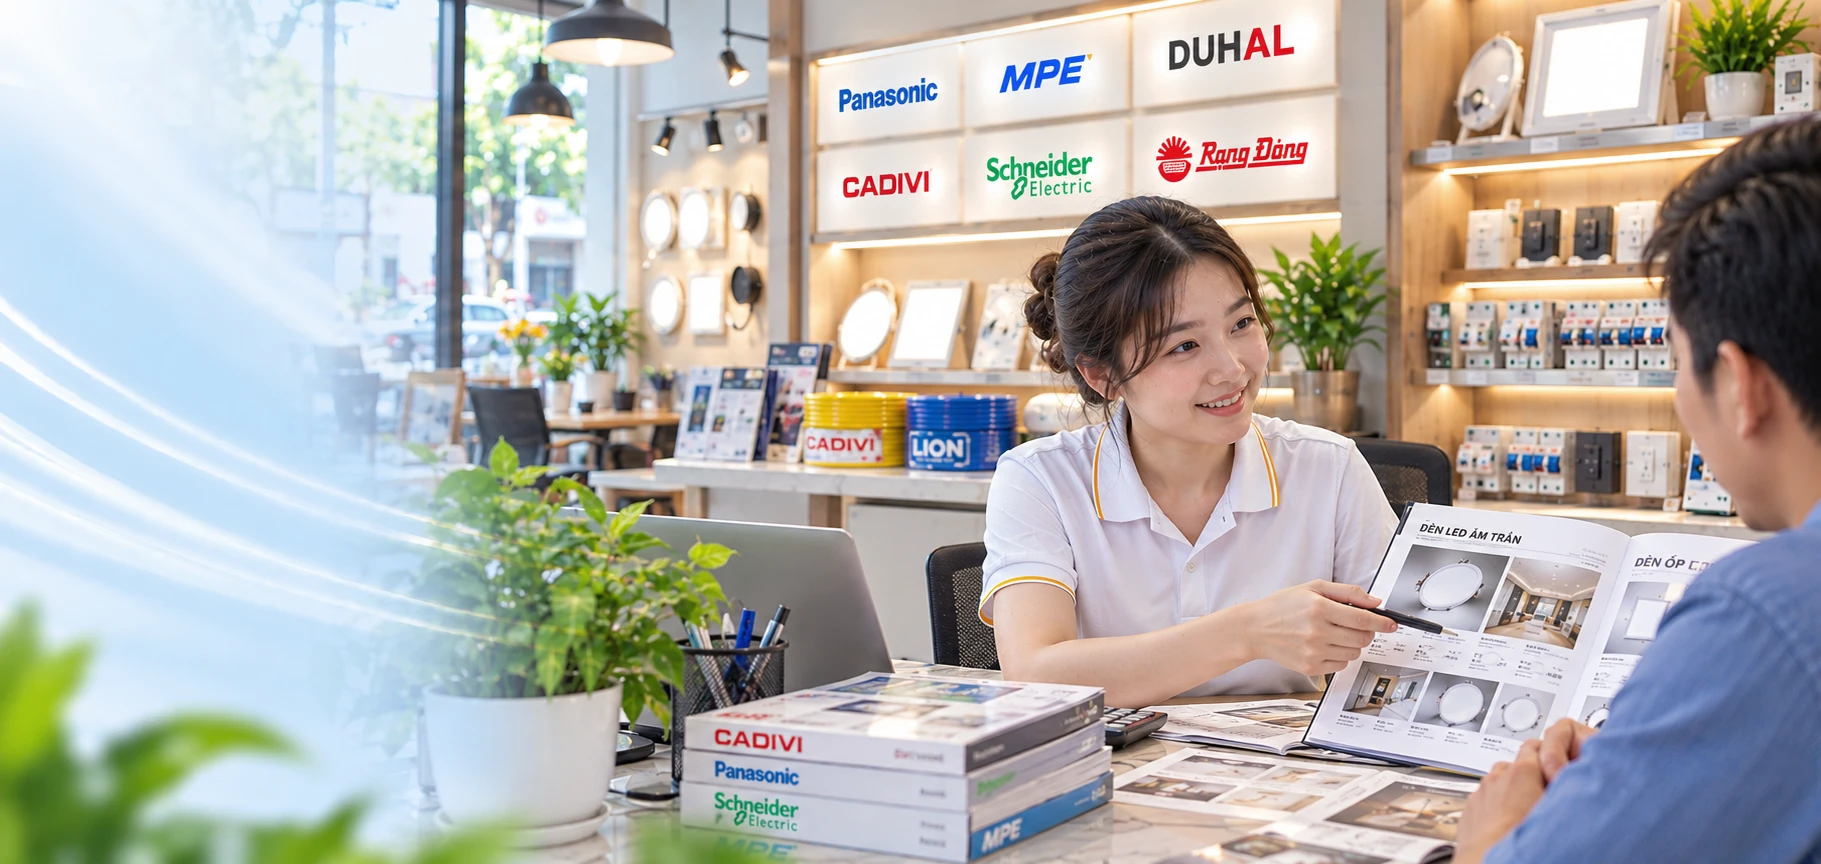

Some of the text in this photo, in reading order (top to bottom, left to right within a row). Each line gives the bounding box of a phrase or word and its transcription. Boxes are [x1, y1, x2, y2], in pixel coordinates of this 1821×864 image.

[1169, 24, 1295, 71] DUHAL
[999, 54, 1087, 94] MPE
[838, 77, 938, 113] Panasonic
[986, 151, 1093, 182] Schneider
[842, 170, 930, 199] CADIVI
[1029, 178, 1092, 197] Electric
[806, 435, 875, 452] CADIVI
[912, 438, 964, 458] LION
[1445, 527, 1468, 538] LED
[714, 728, 803, 753] CADIVI
[714, 760, 800, 786] Panasonic
[714, 792, 800, 819] Schneider
[748, 814, 798, 832] Electric
[980, 817, 1023, 854] MPE
